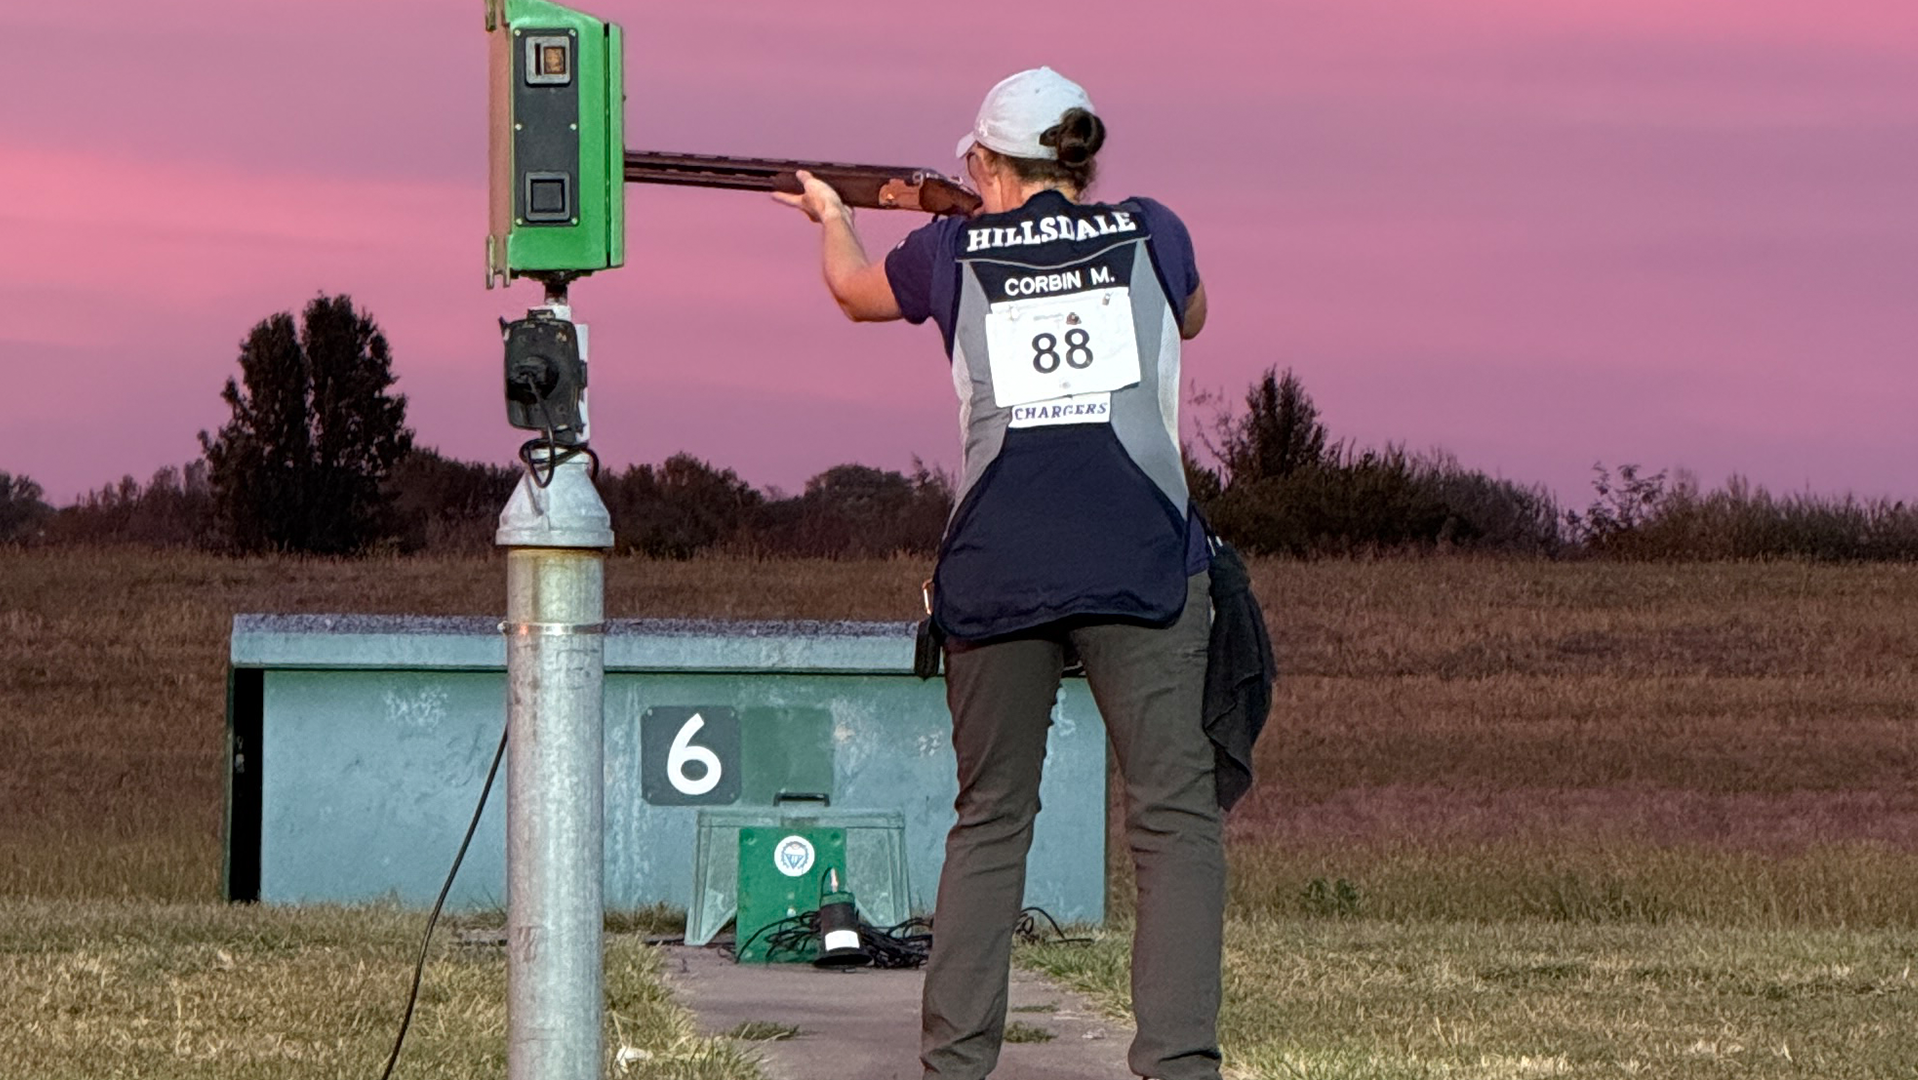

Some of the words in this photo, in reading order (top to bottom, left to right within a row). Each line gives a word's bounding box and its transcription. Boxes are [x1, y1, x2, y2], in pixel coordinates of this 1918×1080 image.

[966, 211, 1137, 252] HILLSDALE
[1004, 270, 1081, 297] CORBIN
[1089, 265, 1115, 286] M.
[1031, 328, 1094, 374] 88
[1014, 402, 1108, 421] CHARGERS
[666, 712, 722, 795] 6
